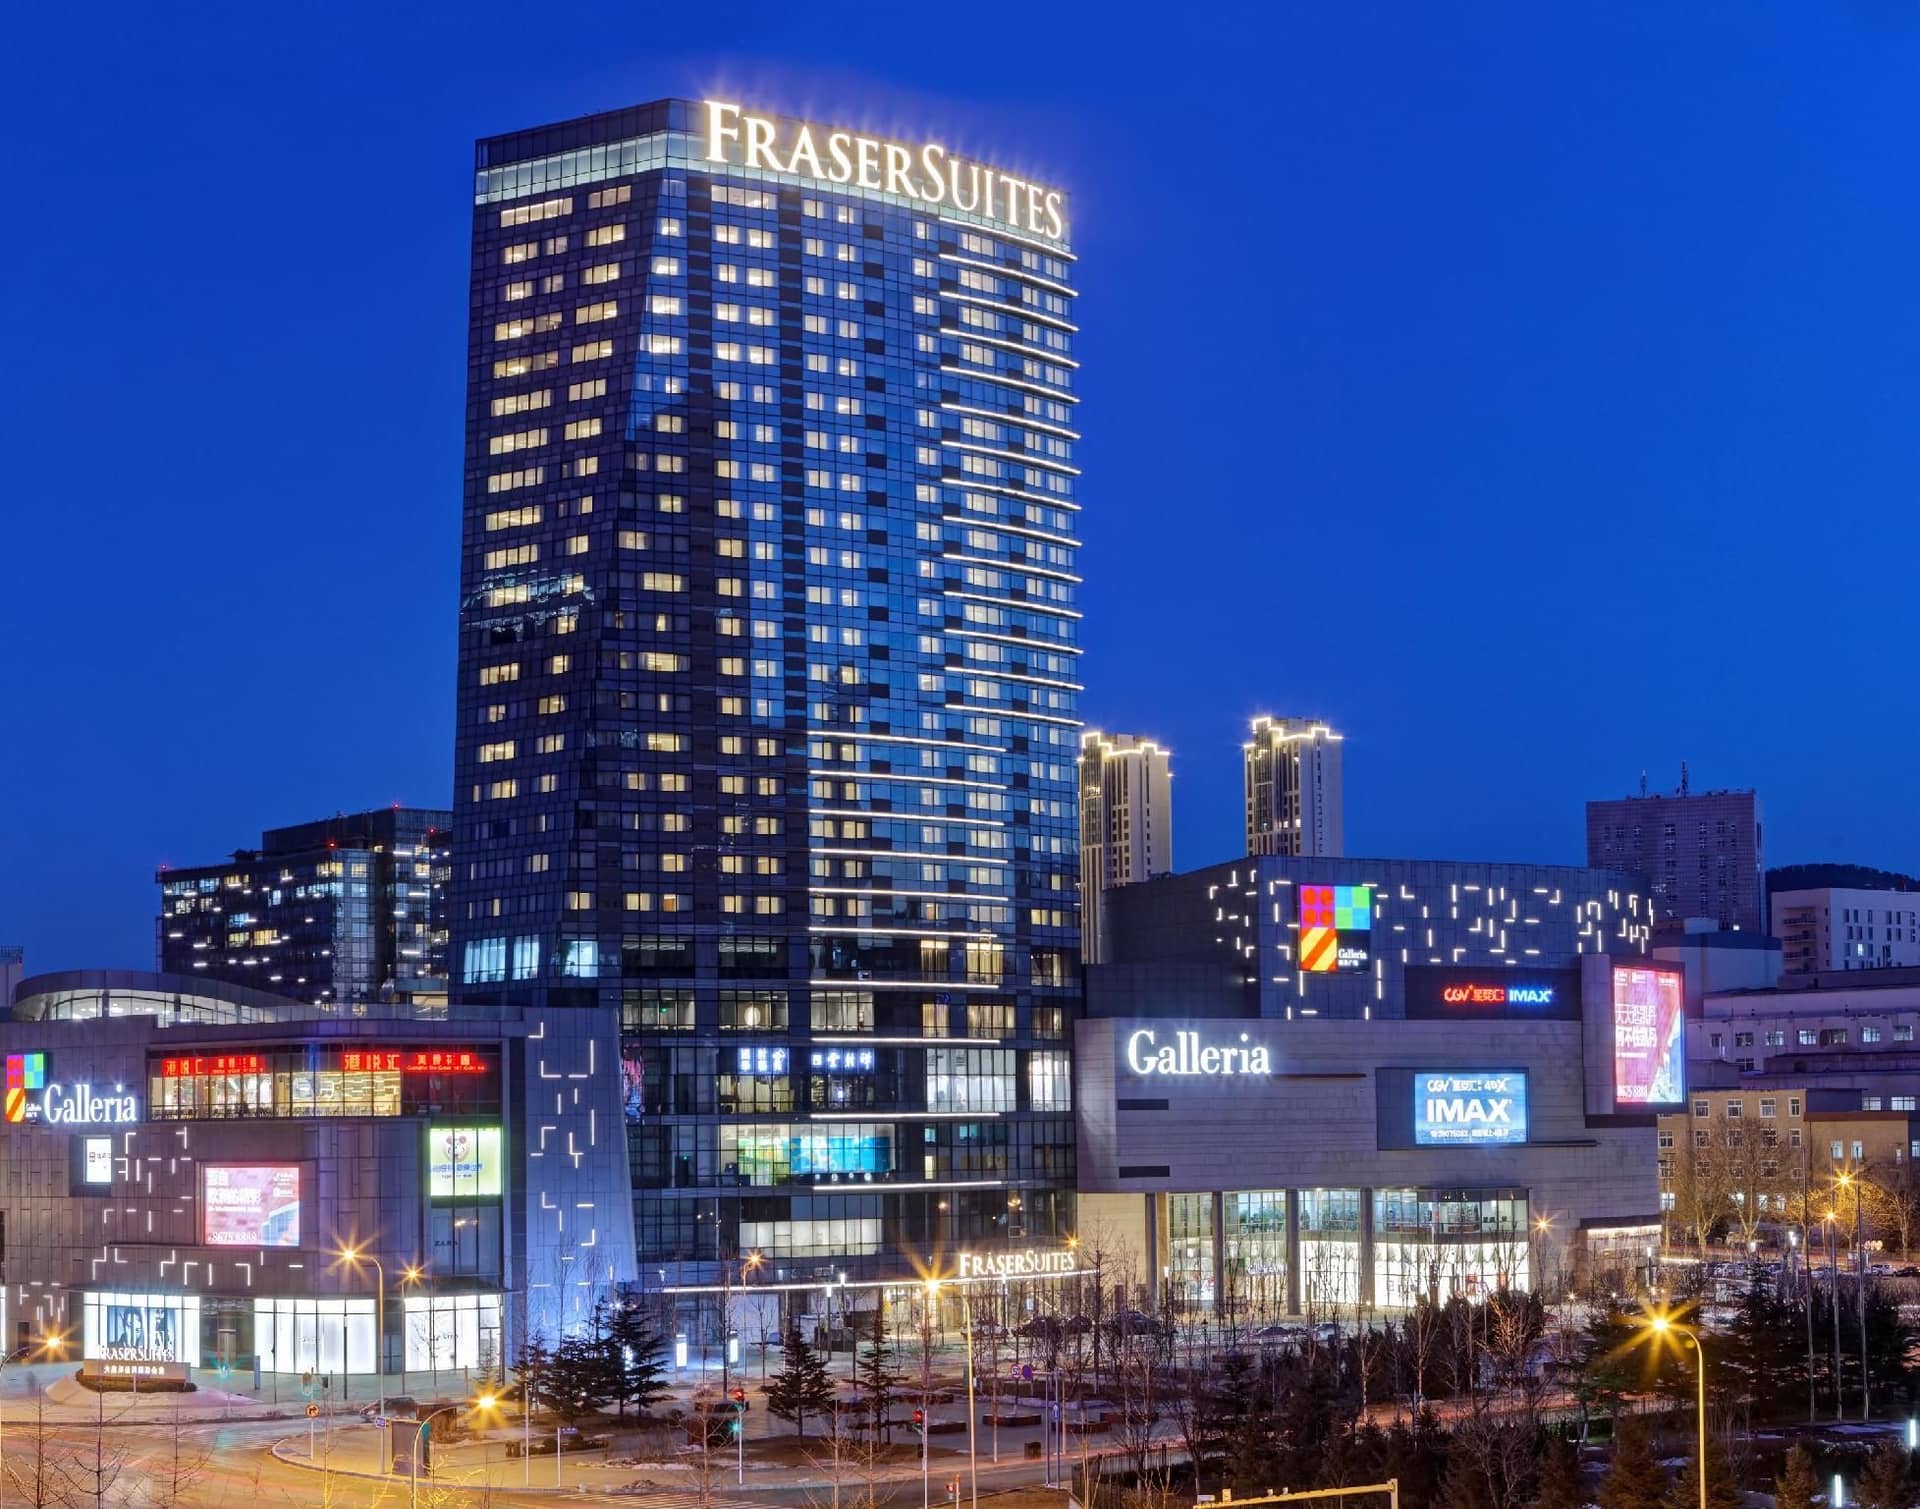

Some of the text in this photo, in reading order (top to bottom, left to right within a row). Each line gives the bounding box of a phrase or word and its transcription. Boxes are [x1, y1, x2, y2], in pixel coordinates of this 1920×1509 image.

[1338, 948, 1368, 959] Galleria
[1444, 988, 1470, 1001] CGV
[1508, 988, 1552, 1002] IMAX
[1127, 1029, 1272, 1075] Galleria
[44, 1083, 138, 1124] Galleria
[1426, 1098, 1511, 1123] IMAX
